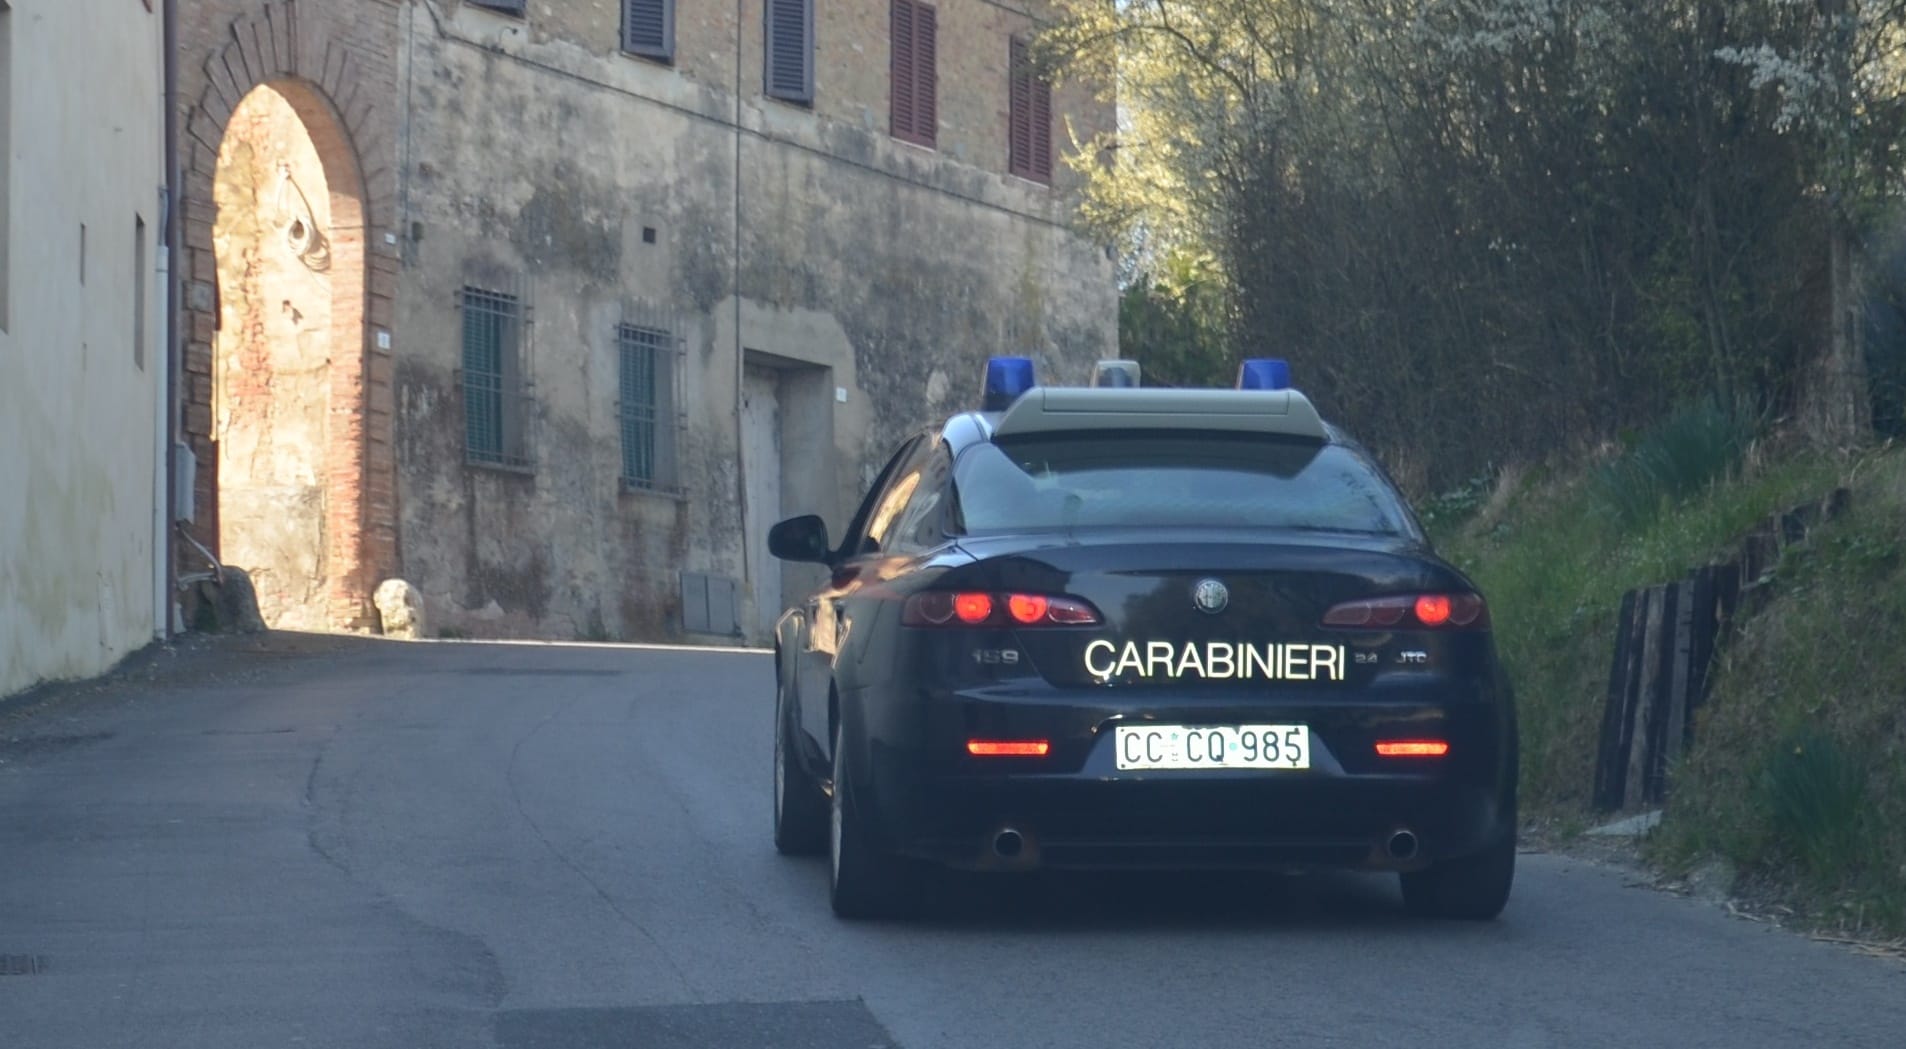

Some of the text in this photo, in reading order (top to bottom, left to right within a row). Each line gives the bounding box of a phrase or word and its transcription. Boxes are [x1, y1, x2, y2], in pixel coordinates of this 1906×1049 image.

[971, 649, 1019, 664] 159
[1084, 639, 1345, 680] CARABINIERI
[1124, 730, 1302, 763] CC CQ 985
